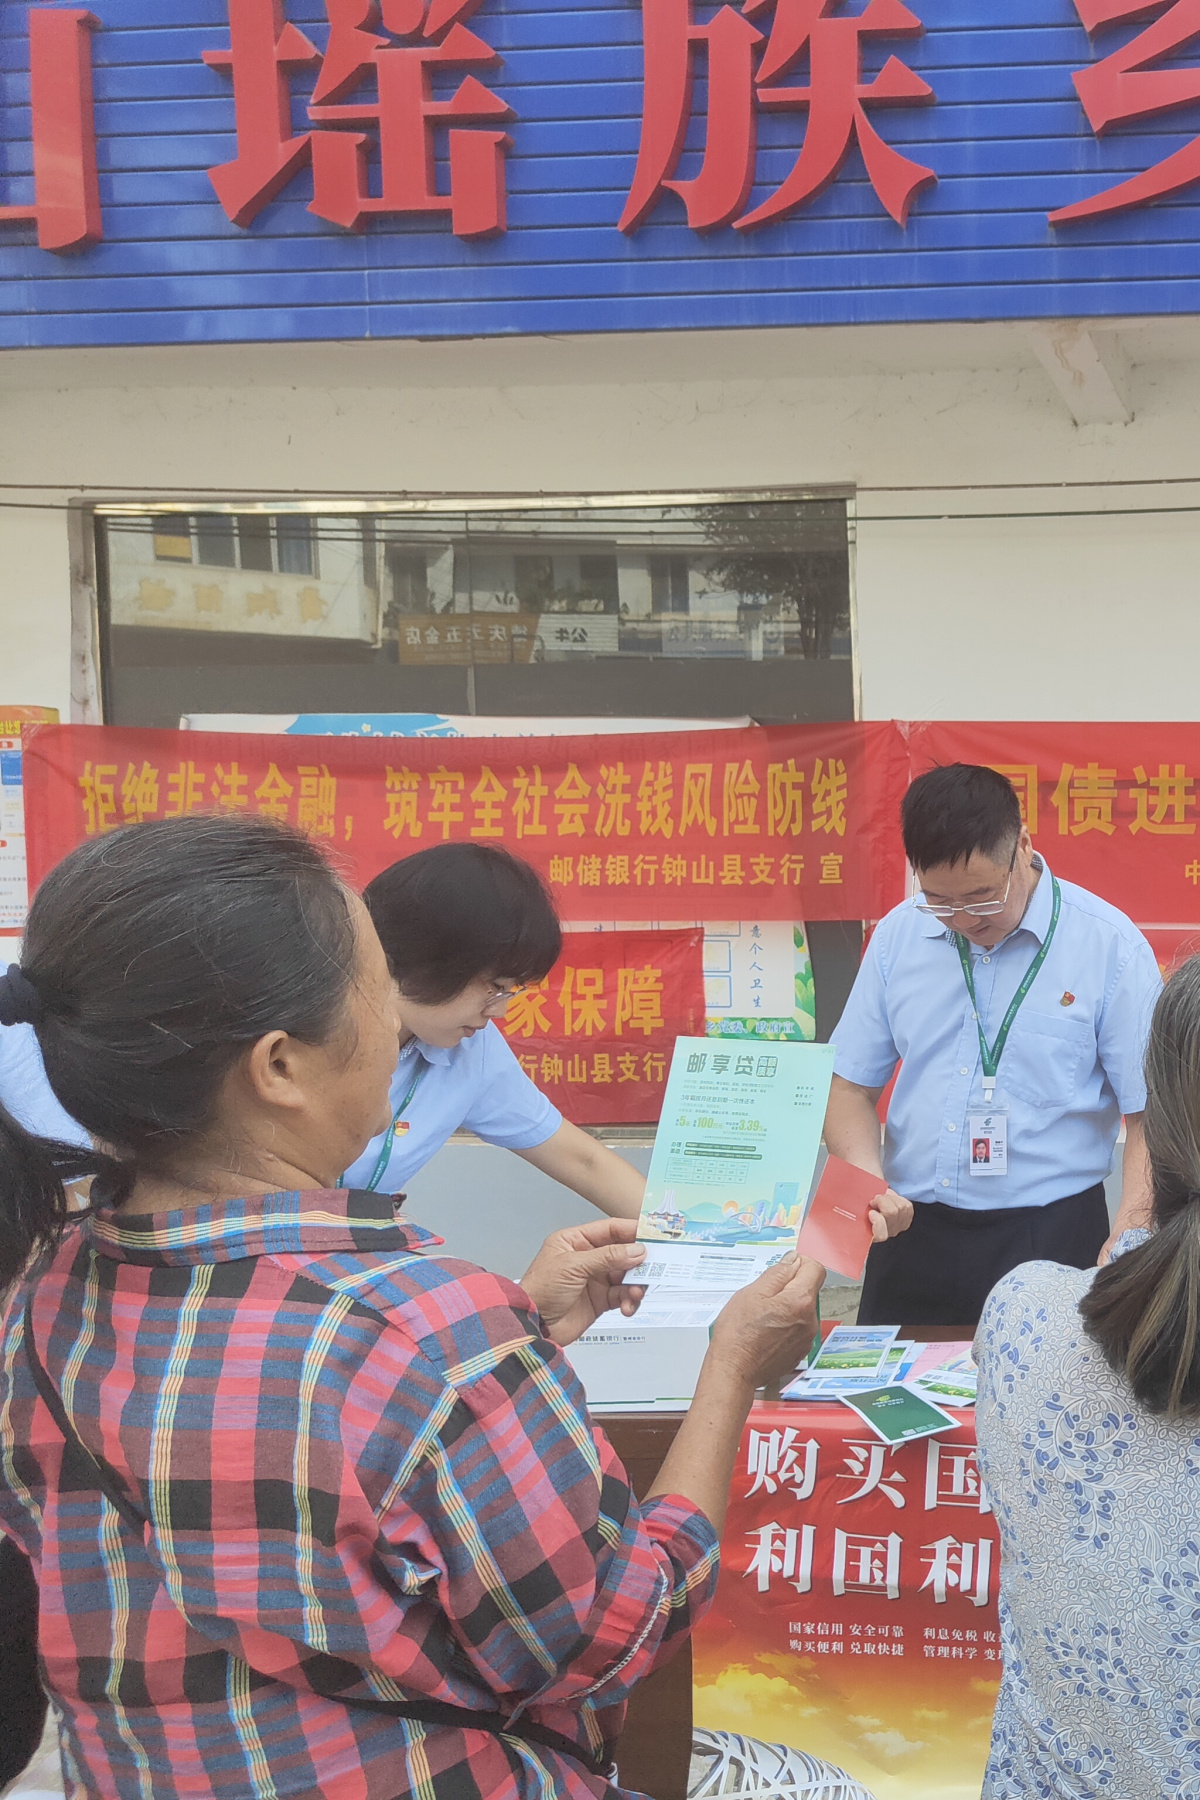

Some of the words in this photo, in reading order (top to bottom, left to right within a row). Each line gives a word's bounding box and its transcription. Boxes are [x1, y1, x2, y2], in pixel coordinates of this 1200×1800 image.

[78, 757, 848, 840] 拒绝非法金融，筑牢全社会洗钱风险防线
[549, 853, 804, 887] 邮储银行钟山县支行
[819, 853, 844, 885] 宣
[503, 964, 665, 1038] 家保障
[518, 1051, 667, 1085] 行钟山县支行
[744, 1427, 993, 1514] 购买国
[742, 1520, 994, 1608] 利国利
[788, 1621, 844, 1636] 国家信用
[849, 1623, 905, 1638] 安全可靠
[923, 1627, 978, 1642] 利息免税
[983, 1631, 1003, 1643] 收
[789, 1639, 844, 1654] 购买便利
[849, 1641, 905, 1656] 兑取快捷
[923, 1644, 979, 1660] 管理科学
[983, 1648, 1003, 1661] 变
